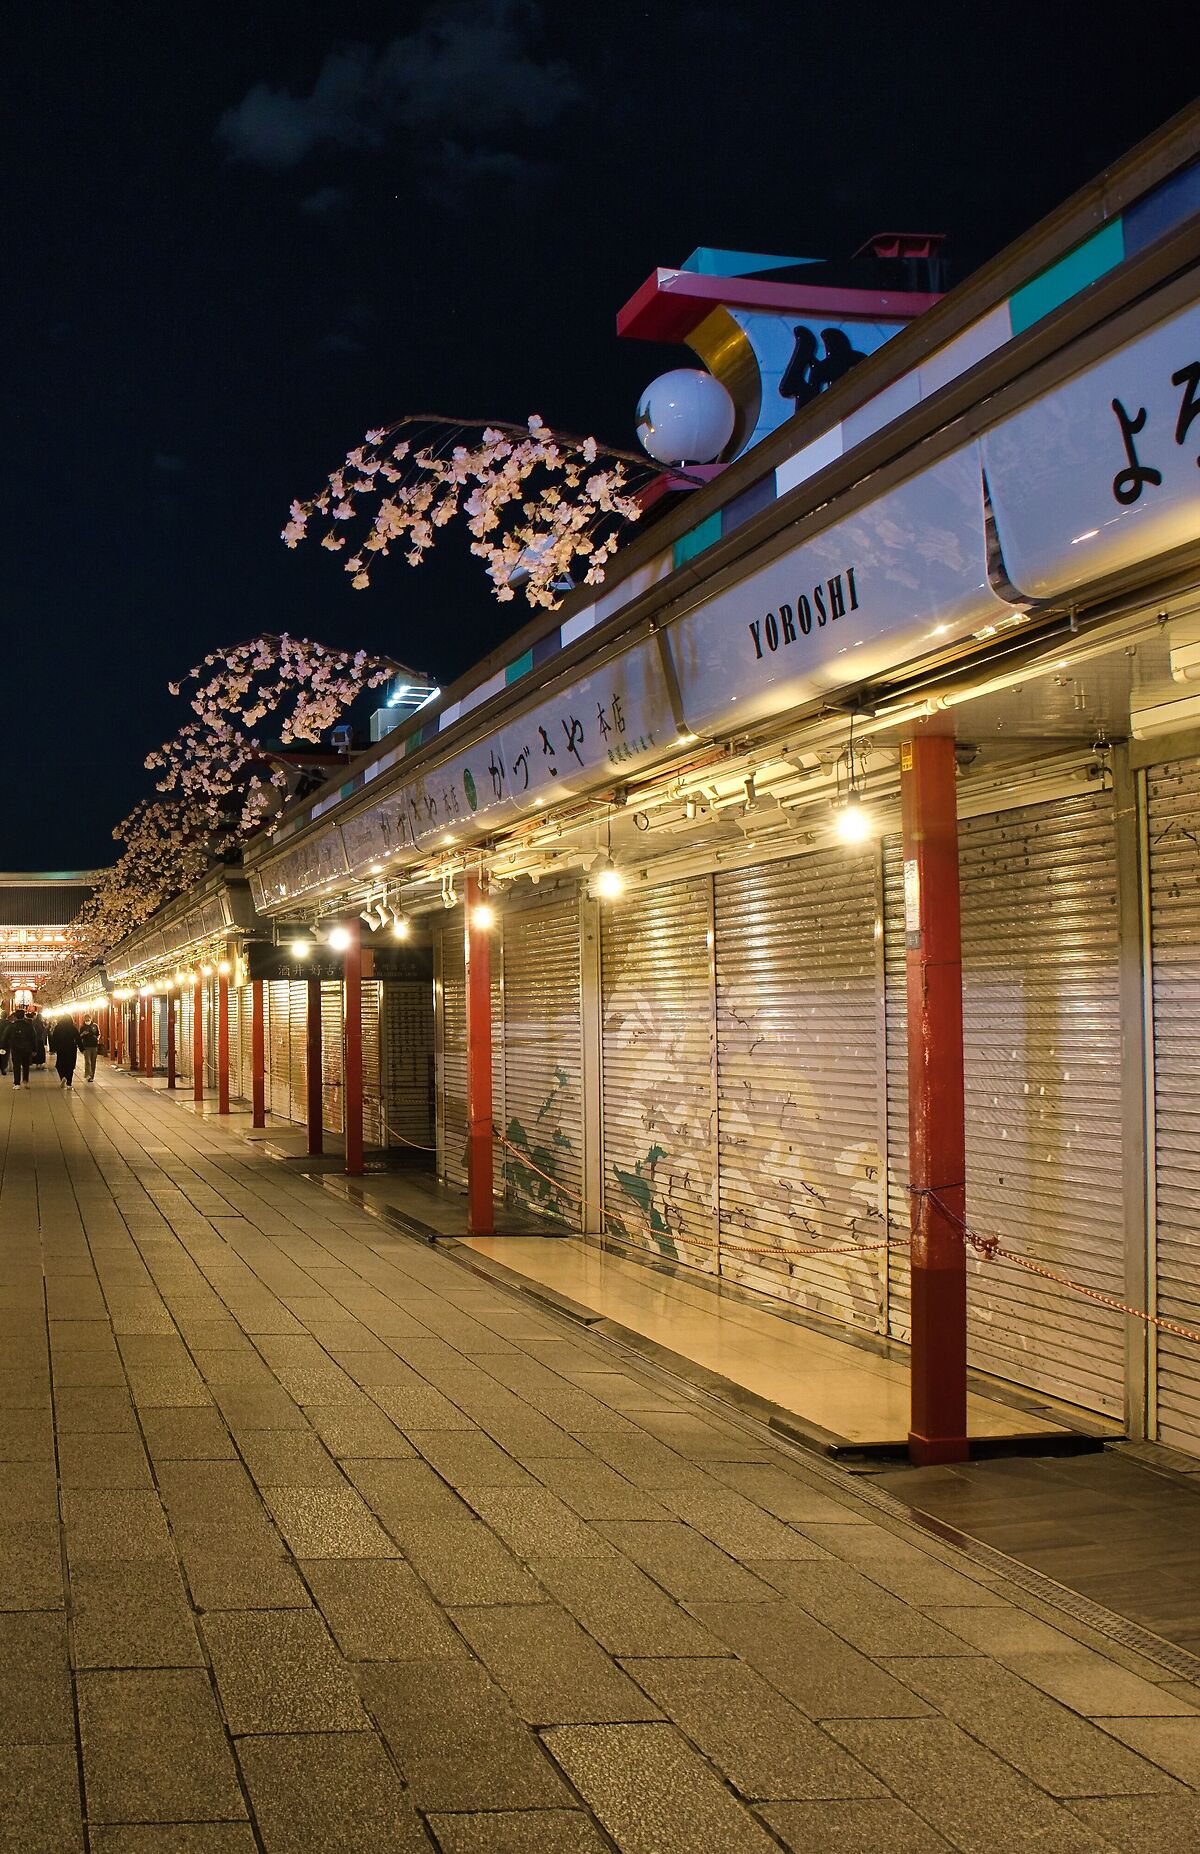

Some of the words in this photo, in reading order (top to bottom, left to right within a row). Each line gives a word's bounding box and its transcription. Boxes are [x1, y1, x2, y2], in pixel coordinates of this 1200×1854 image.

[749, 567, 860, 660] YOROSHI
[278, 963, 344, 977] 酒井好古
